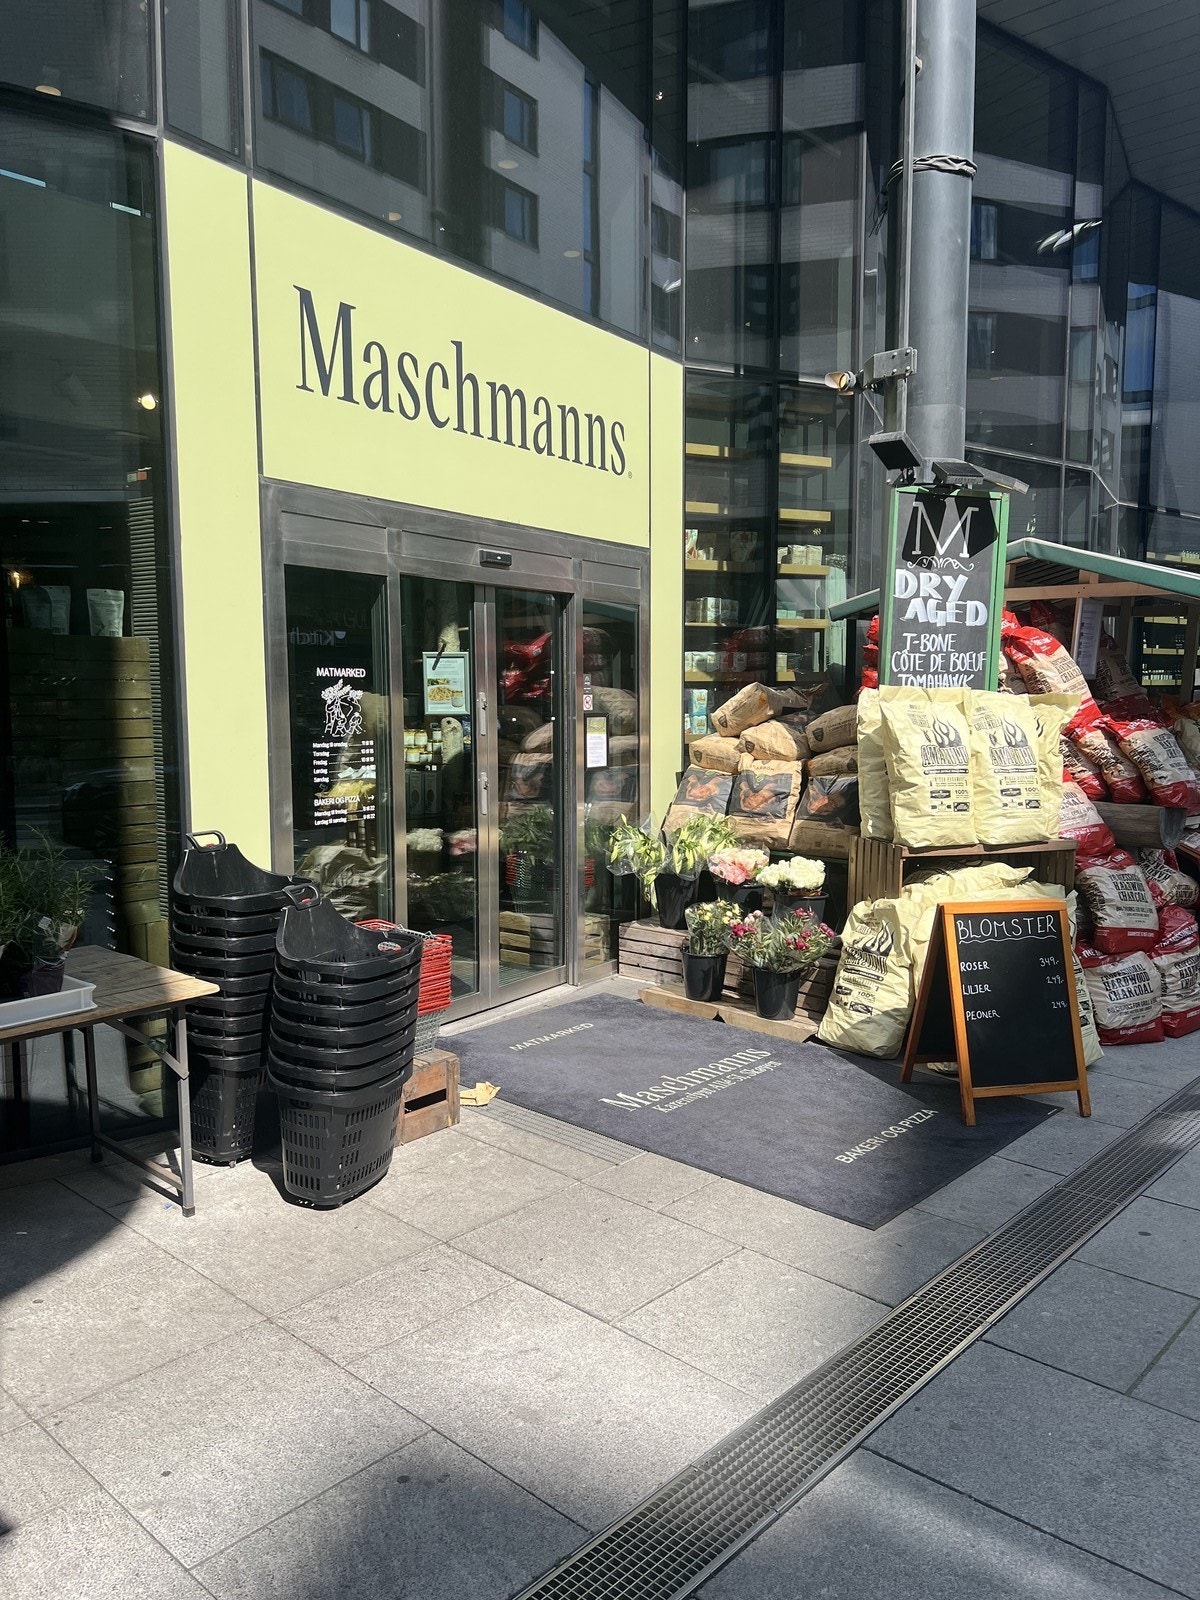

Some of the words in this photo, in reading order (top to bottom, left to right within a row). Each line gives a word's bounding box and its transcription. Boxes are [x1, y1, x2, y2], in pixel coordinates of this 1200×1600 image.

[292, 284, 627, 476] Maschmanns
[912, 501, 980, 558] M
[893, 568, 969, 602] DRY
[900, 597, 988, 627] AGED
[902, 632, 957, 652] T-BONE
[316, 667, 366, 678] MATMARKED
[891, 649, 926, 673] CÔTE
[930, 653, 947, 673] DE
[956, 914, 1056, 940] BLOMSTER
[960, 961, 990, 972] ROSER
[963, 984, 992, 995] LILJER
[1103, 972, 1150, 992] HARDWOOD
[1108, 982, 1154, 1002] CHARCOAL
[966, 1010, 1000, 1021] PEONER
[509, 1022, 594, 1052] MATMARKED
[599, 1048, 772, 1112] Maschmanns
[834, 1136, 884, 1164] BAKERI
[880, 1126, 908, 1140] OG
[898, 1108, 939, 1130] PIZZA
